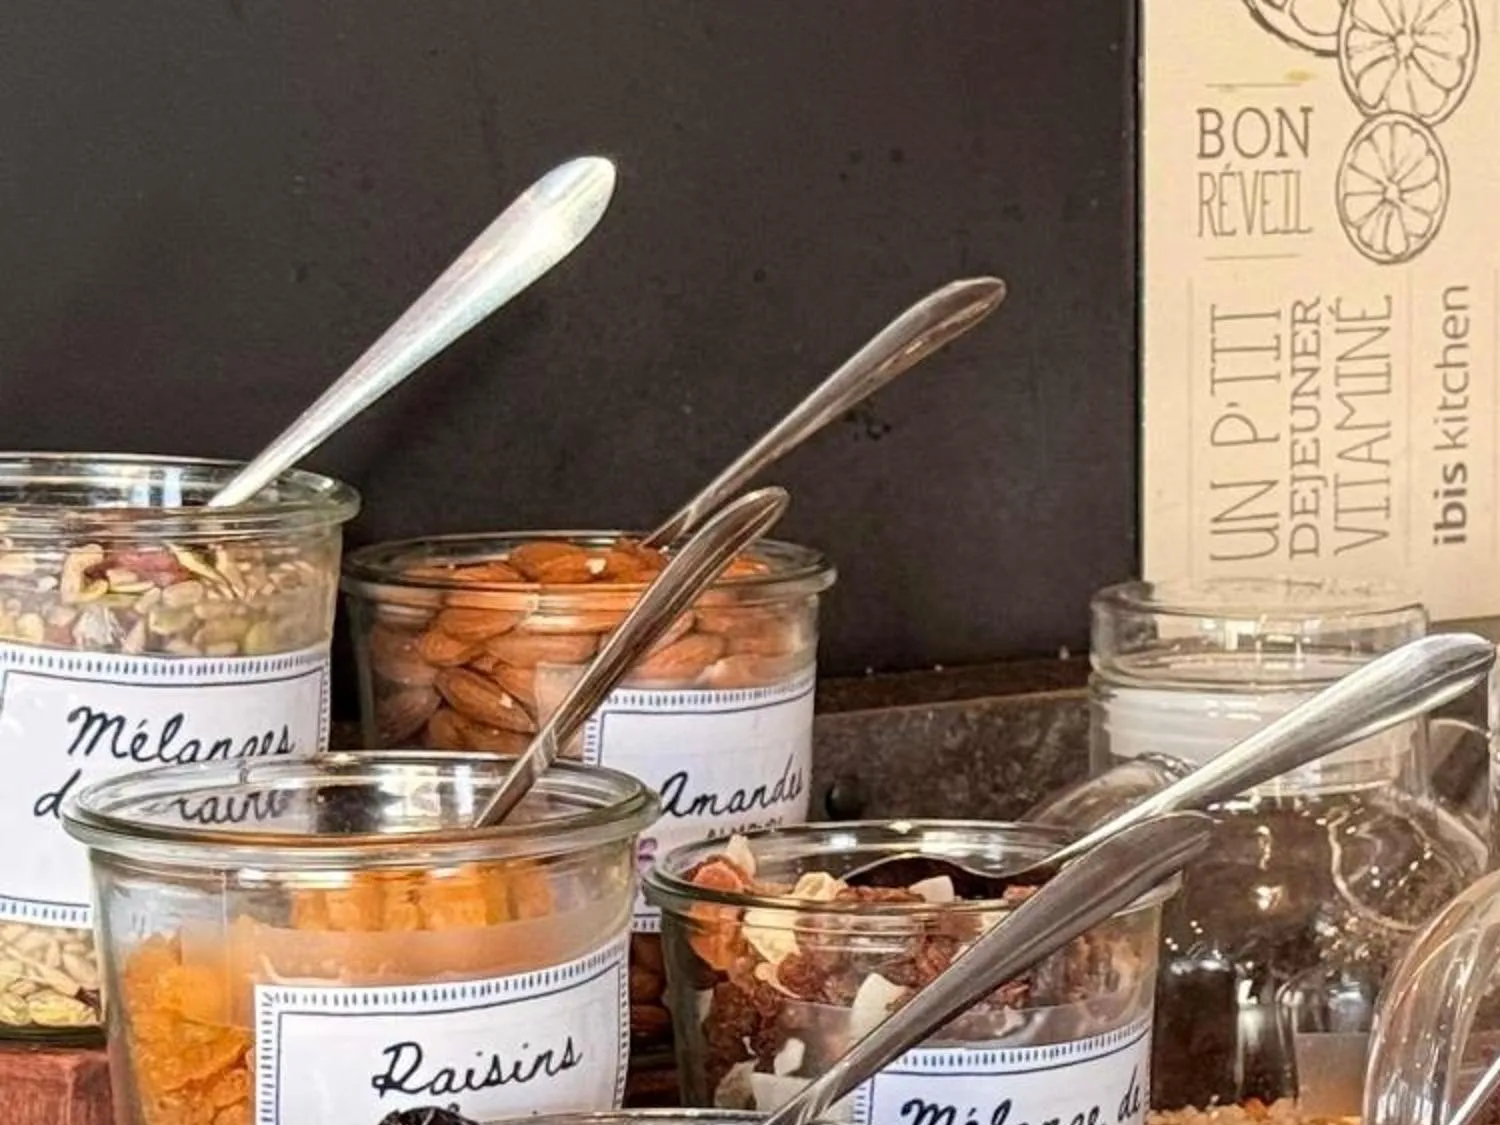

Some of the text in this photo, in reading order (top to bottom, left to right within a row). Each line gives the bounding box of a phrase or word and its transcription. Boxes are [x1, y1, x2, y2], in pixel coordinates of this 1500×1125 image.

[1196, 105, 1313, 159] BON
[1197, 161, 1314, 238] RÉVEIL
[1327, 294, 1392, 557] VITAMINÉ
[1433, 285, 1470, 546] ibis kitchen
[1209, 479, 1280, 562] UN
[372, 1036, 584, 1099] Raisins
